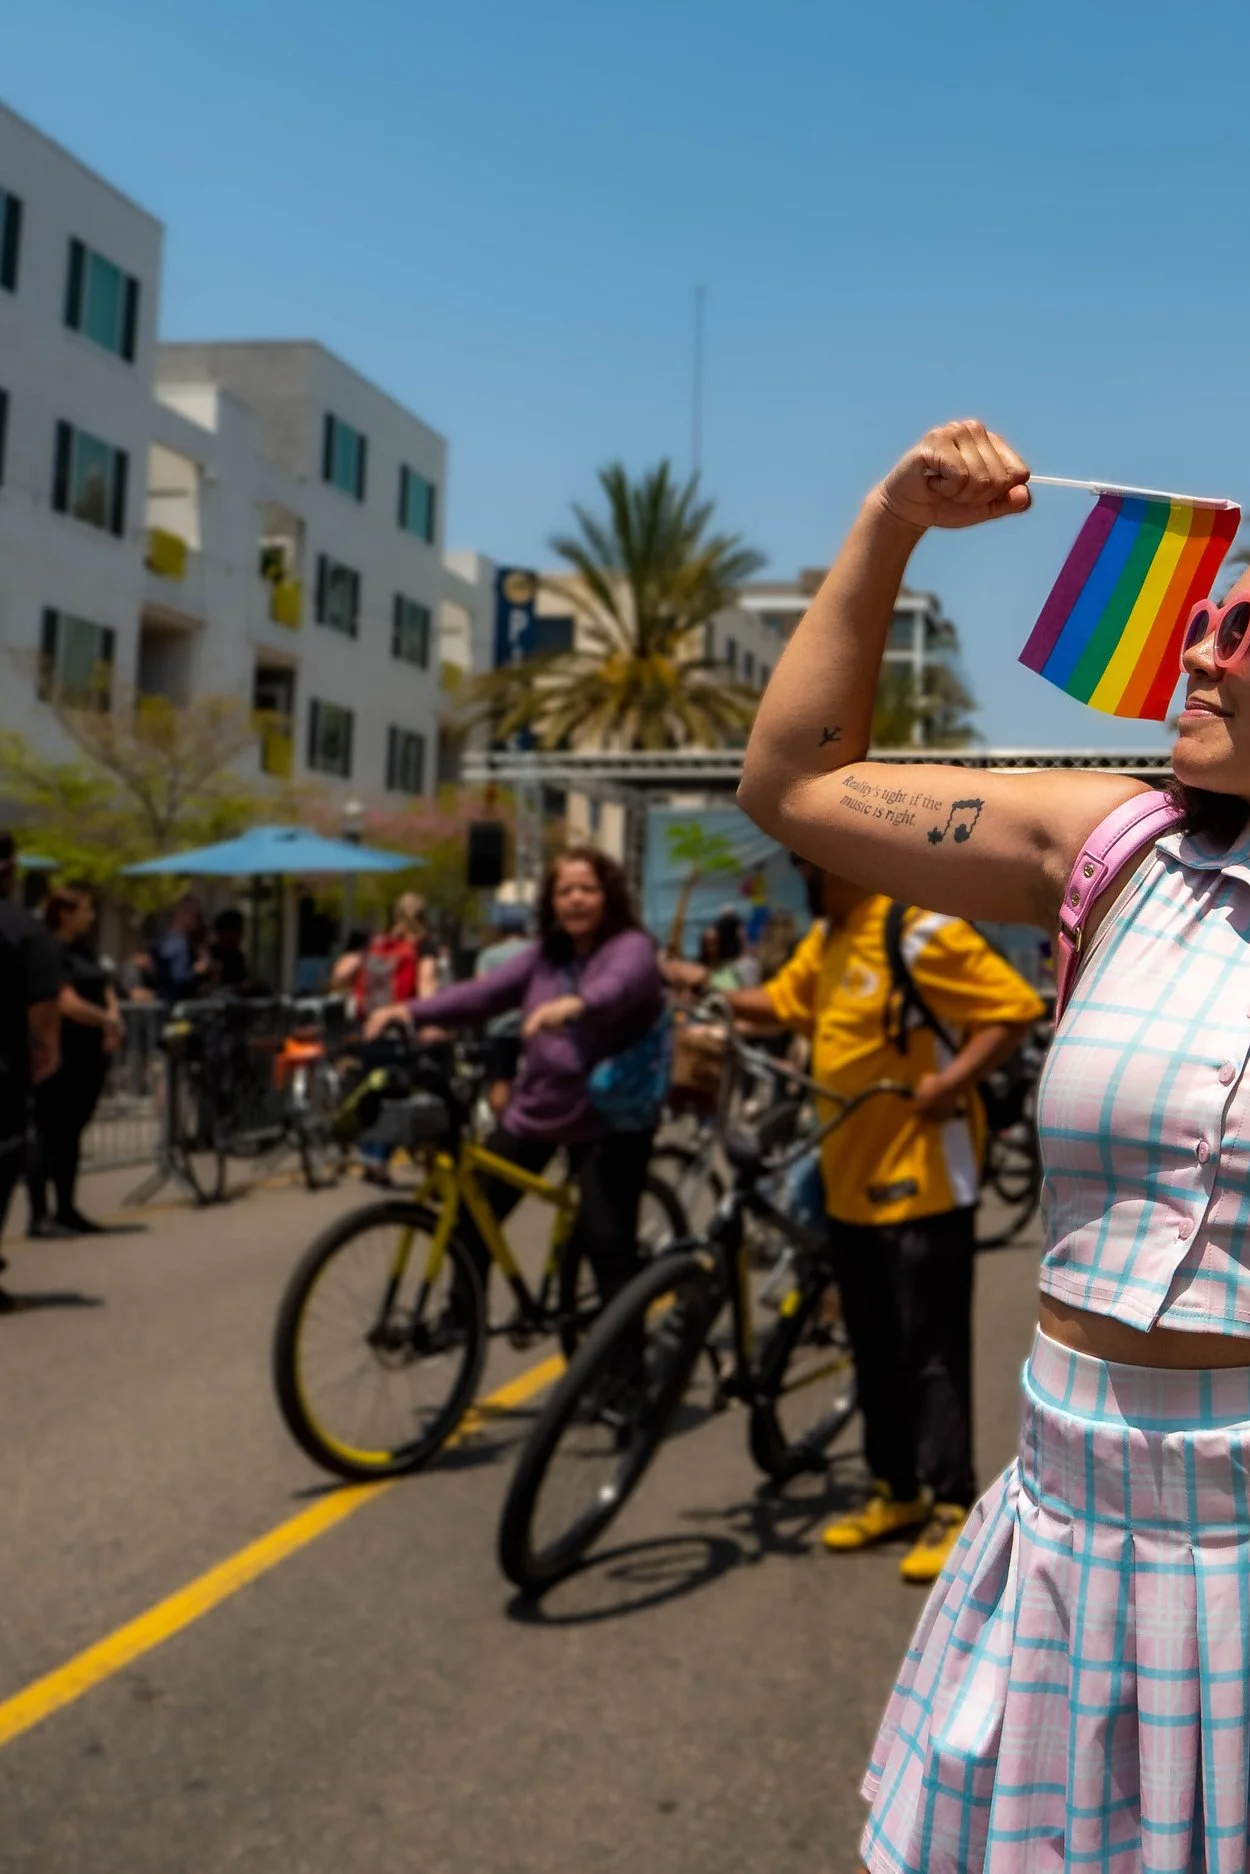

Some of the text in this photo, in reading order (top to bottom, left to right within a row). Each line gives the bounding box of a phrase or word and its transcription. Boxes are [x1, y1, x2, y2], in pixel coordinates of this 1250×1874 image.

[842, 775, 942, 811] Reality's tight if the
[840, 795, 916, 826] music is right.
